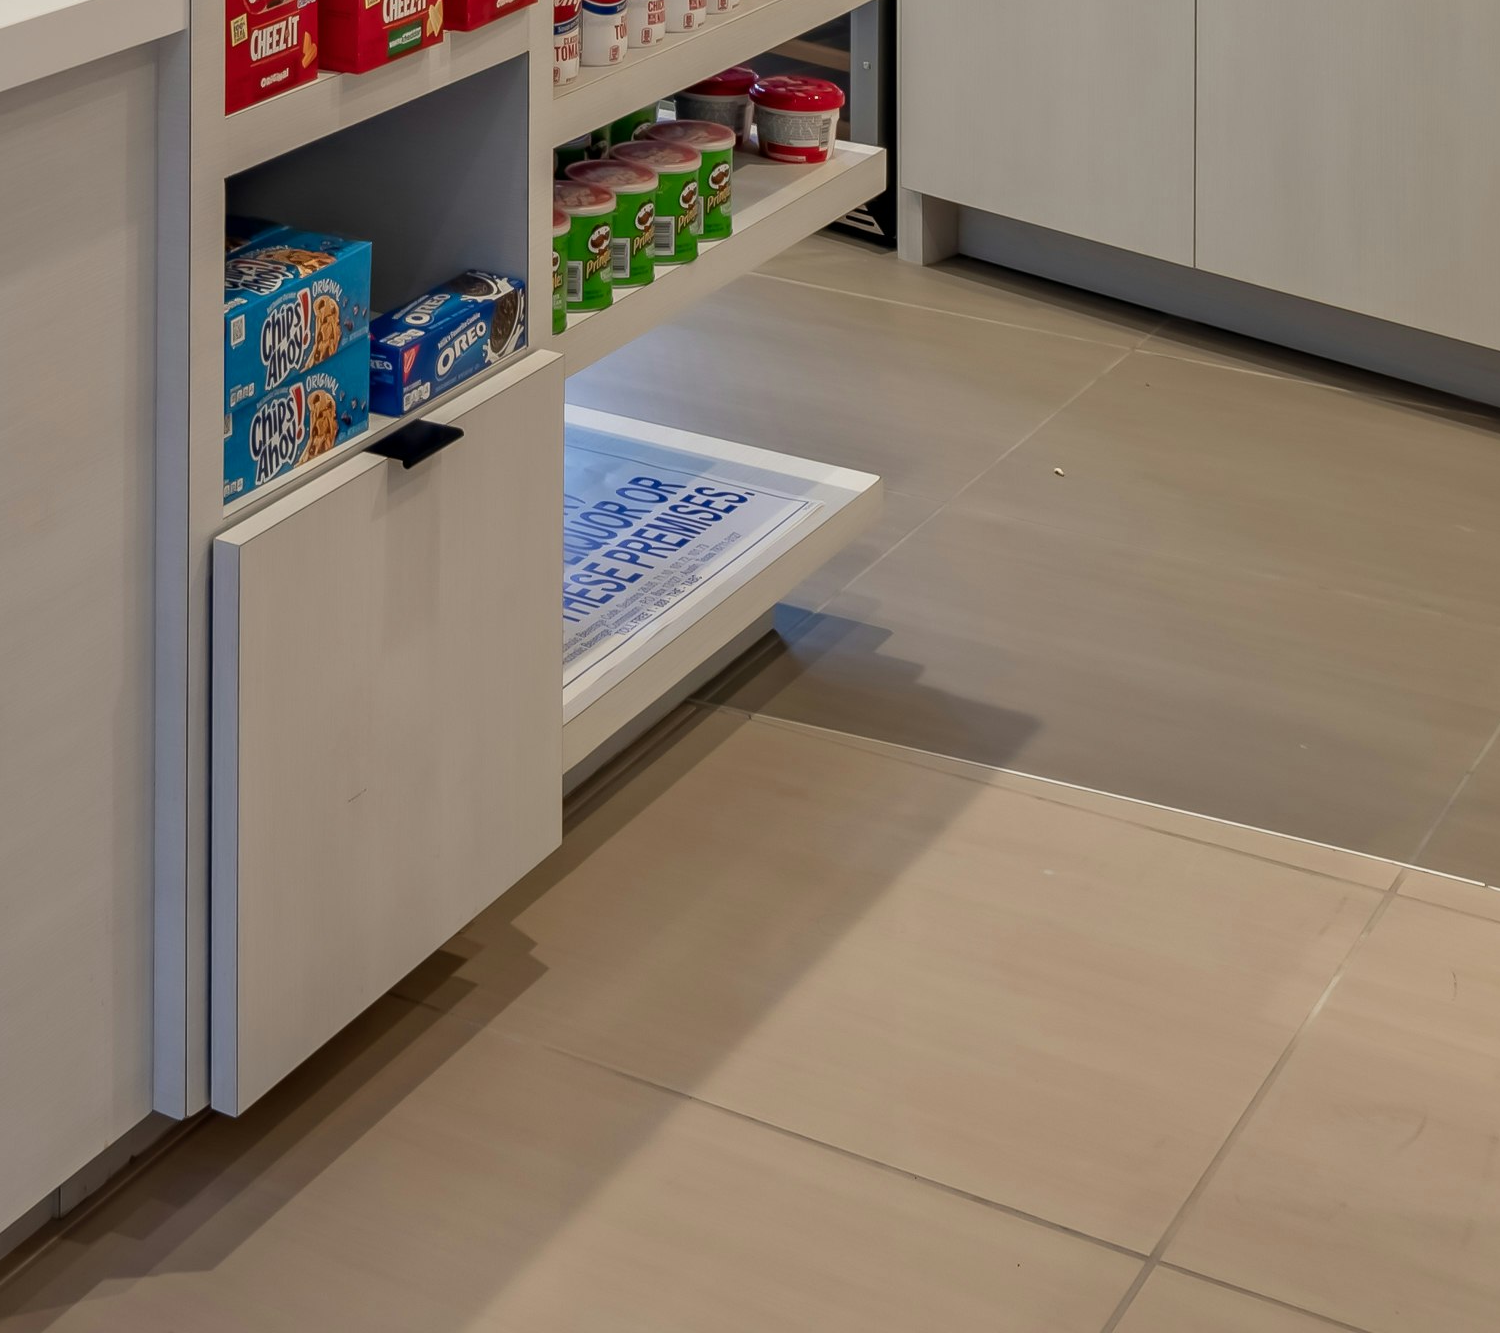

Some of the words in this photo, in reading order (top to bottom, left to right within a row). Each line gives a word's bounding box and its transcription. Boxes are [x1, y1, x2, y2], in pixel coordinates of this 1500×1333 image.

[312, 279, 342, 302] ORIGINAL
[405, 293, 451, 325] OREO
[437, 322, 487, 376] OREO
[306, 373, 340, 395] ORIGINAL
[615, 476, 687, 505] OR
[602, 486, 756, 584] PREMISES.
